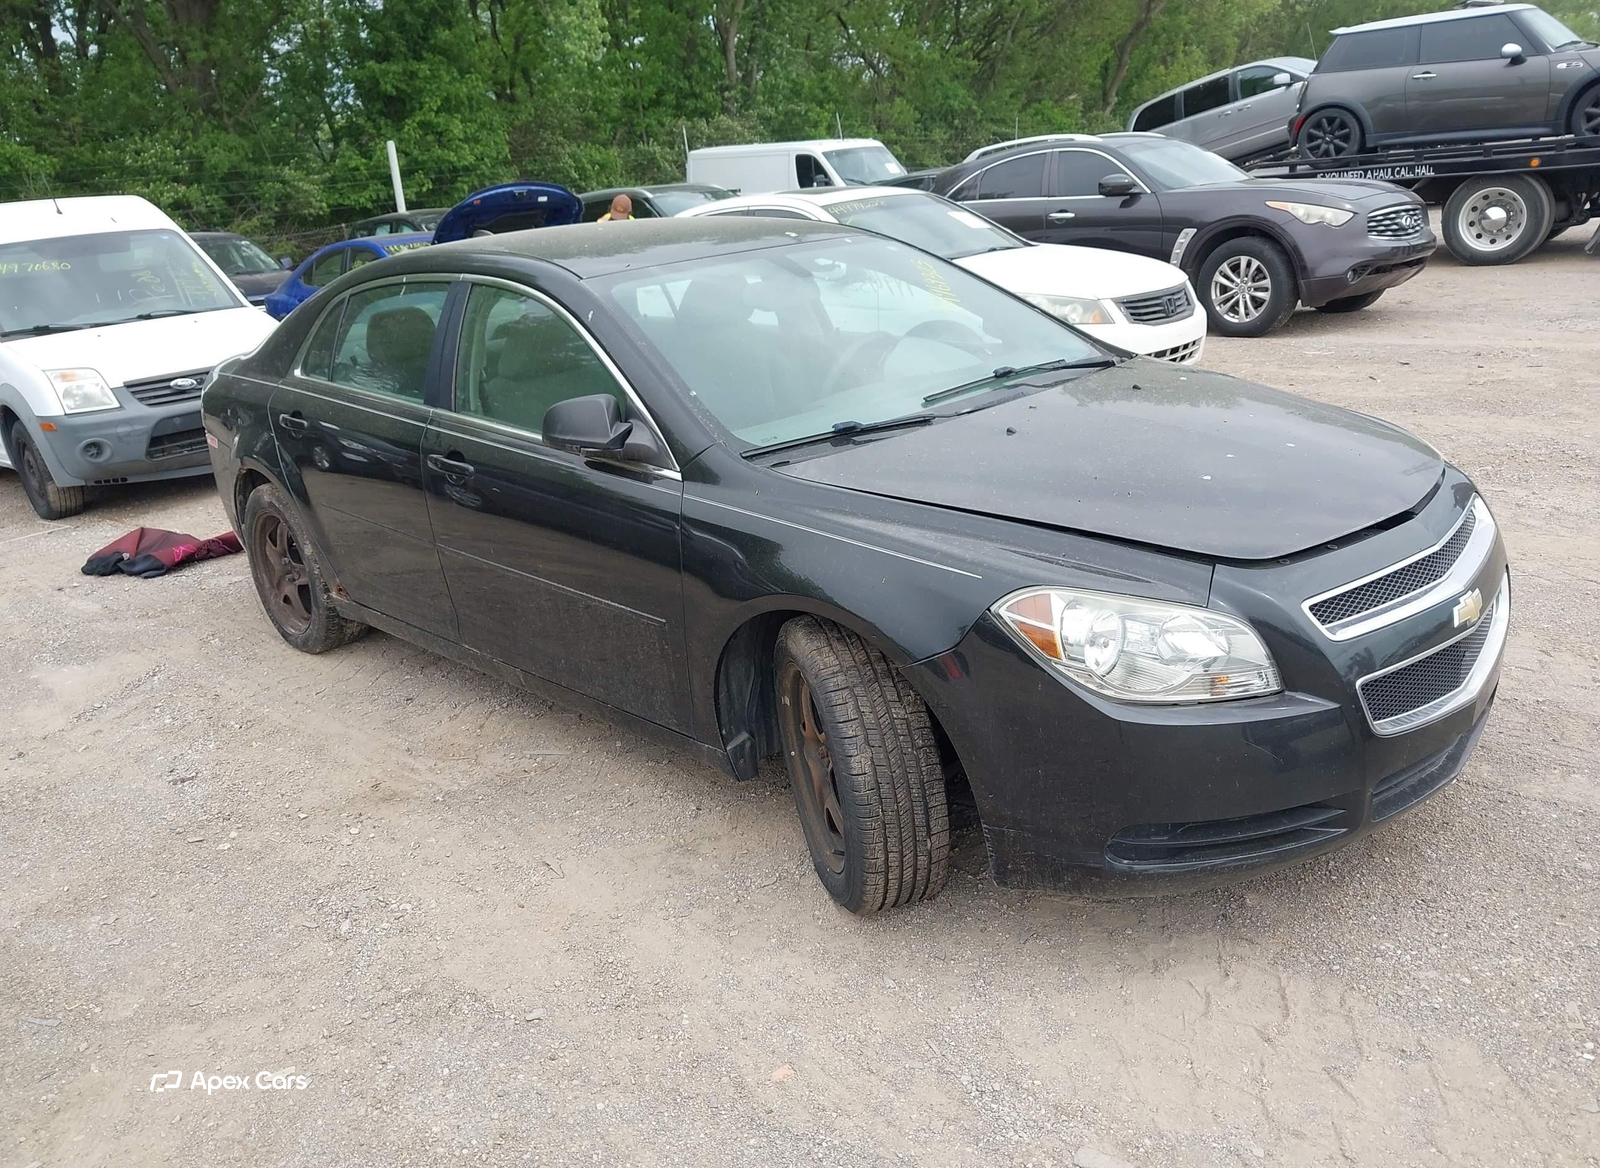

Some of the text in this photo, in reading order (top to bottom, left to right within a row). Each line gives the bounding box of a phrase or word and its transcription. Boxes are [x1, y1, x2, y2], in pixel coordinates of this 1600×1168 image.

[1343, 169, 1365, 179] NEED
[1366, 169, 1373, 180] A
[1373, 166, 1394, 180] HAUL
[1394, 165, 1414, 179] CALL
[1414, 164, 1435, 176] HALL
